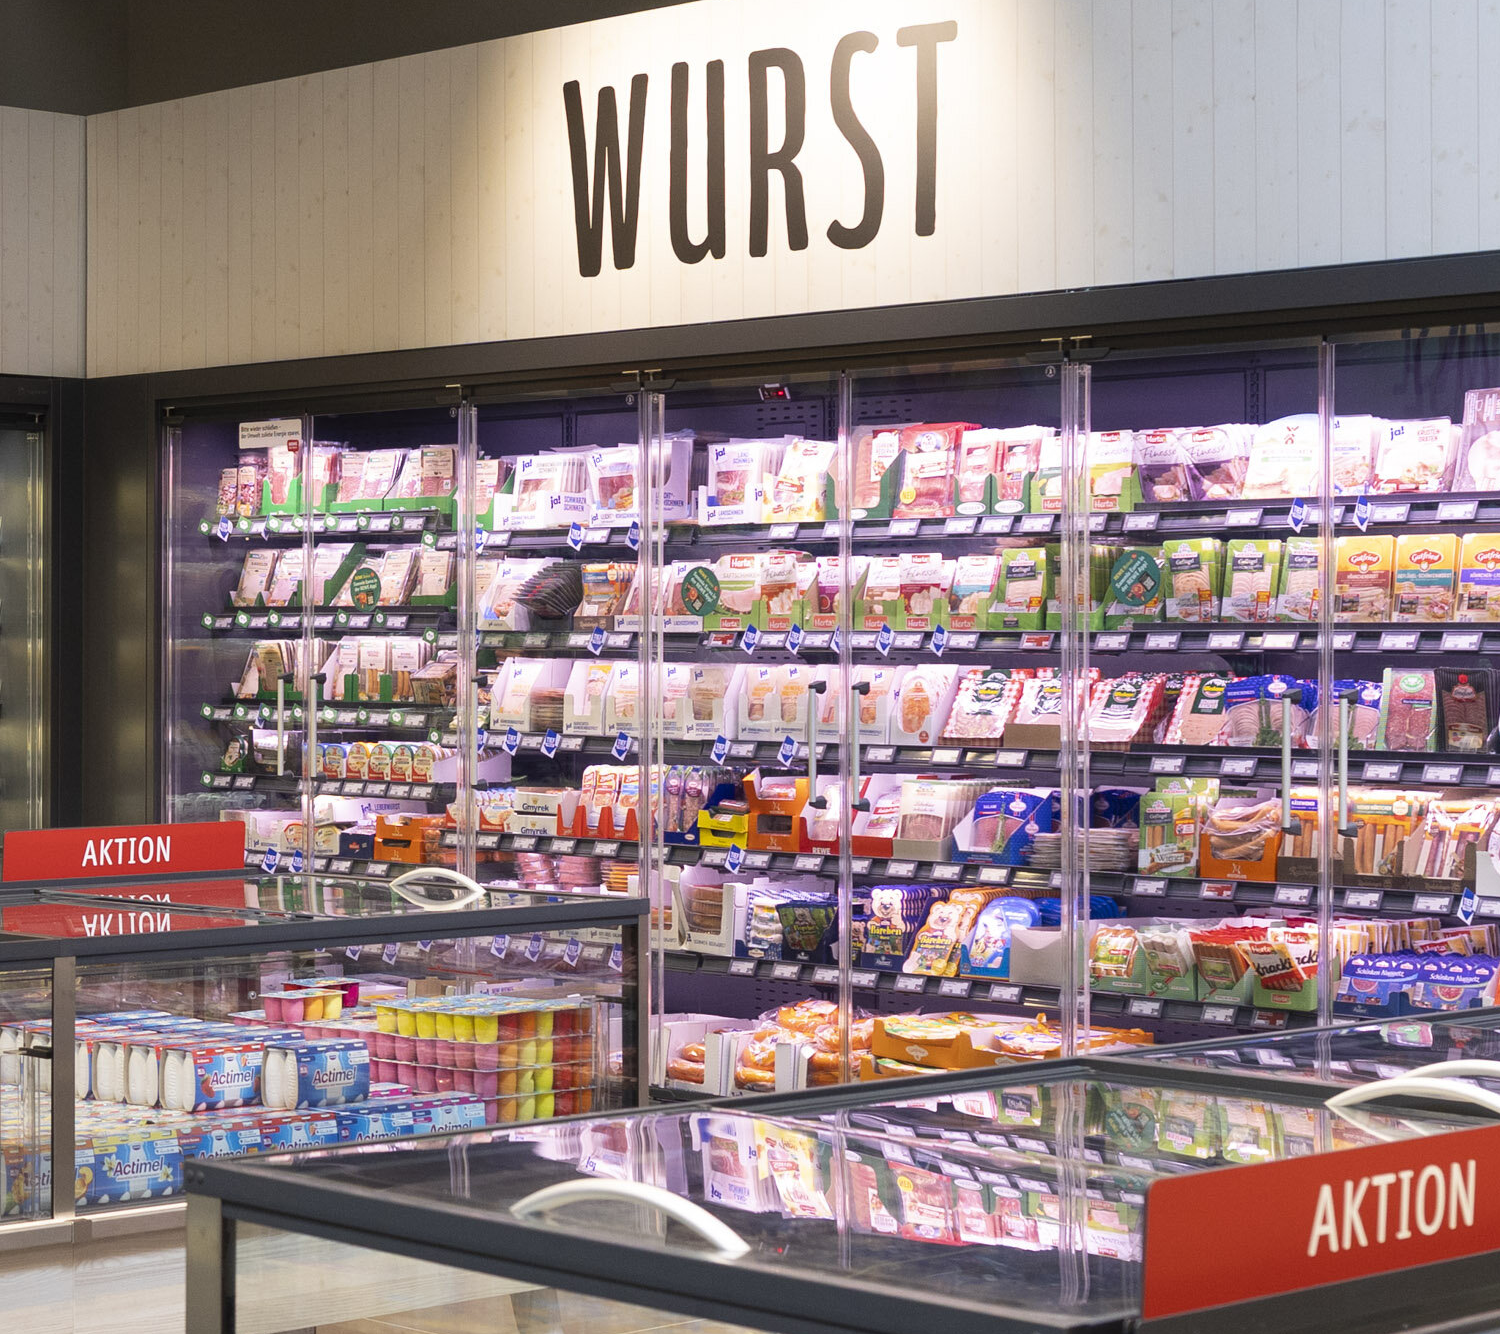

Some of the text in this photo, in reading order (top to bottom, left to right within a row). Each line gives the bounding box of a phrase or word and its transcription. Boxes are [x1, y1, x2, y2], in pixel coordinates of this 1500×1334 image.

[563, 19, 959, 277] WURST
[521, 801, 550, 813] Gmyrek
[81, 835, 171, 868] AKTION
[209, 1068, 255, 1088] Actimel
[312, 1067, 358, 1085] Actimel
[113, 1157, 165, 1176] Actimel
[1307, 1159, 1477, 1257] AKTION
